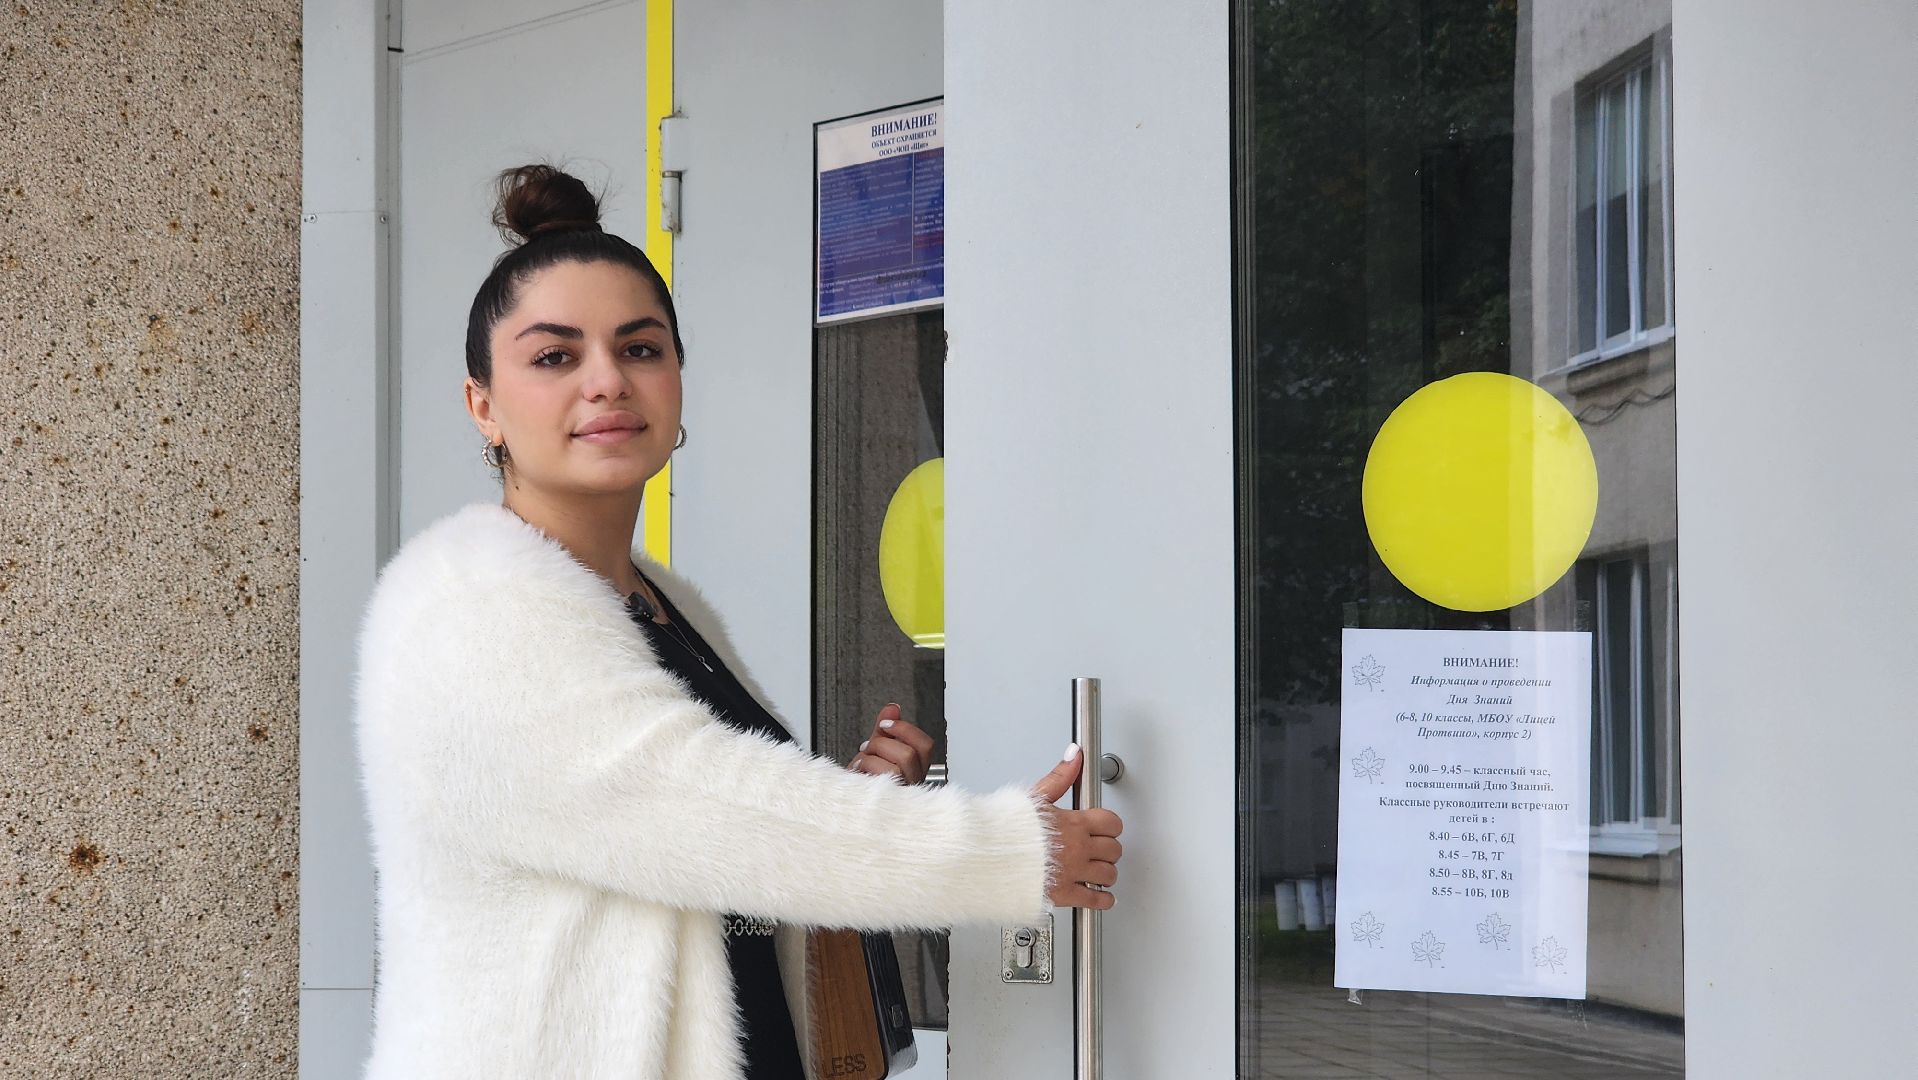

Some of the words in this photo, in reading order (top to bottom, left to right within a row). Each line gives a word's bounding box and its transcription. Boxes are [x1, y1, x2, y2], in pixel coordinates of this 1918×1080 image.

[871, 112, 937, 137] ВНИМАНИЕ!
[871, 137, 896, 149] ОБЪЕКТ
[896, 129, 937, 143] ОХРАНЯЕТСЯ
[879, 148, 892, 157] ООО
[1443, 657, 1519, 668] ВНИМАНИЕ!
[1410, 675, 1479, 687] Информация
[1491, 678, 1551, 688] проведении
[1446, 694, 1468, 705] Дня
[1473, 694, 1513, 705] Знаний
[1421, 712, 1433, 722] 10
[1435, 715, 1474, 724] классы,
[1477, 713, 1513, 723] МБОУ
[1516, 714, 1555, 725] «Лицей
[1417, 727, 1480, 740] Протвино»,
[1483, 731, 1519, 741] корпус
[1521, 729, 1532, 740] 2)
[1409, 764, 1430, 774] 9.00
[1440, 764, 1462, 775] 9.45
[1473, 766, 1526, 776] классный
[1530, 768, 1551, 777] час,
[1405, 779, 1480, 790] посвященный
[1482, 781, 1508, 792] Дню
[1510, 781, 1554, 792] Знаний.
[1379, 796, 1431, 808] Классные
[1433, 799, 1508, 810] руководители
[1511, 802, 1570, 812] встречают
[1449, 814, 1479, 824] детей
[1429, 831, 1450, 841] 8.40
[1461, 832, 1479, 843] 6В,
[1481, 832, 1498, 843] 6Г,
[1501, 833, 1515, 844] 6Д
[1438, 849, 1460, 860] 8.45
[1471, 850, 1488, 861] 7В,
[1491, 851, 1504, 861] 7Г
[1429, 867, 1450, 878] 8.50
[1461, 868, 1479, 880] 8В,
[1481, 869, 1498, 880] 8Г,
[1501, 870, 1513, 881] 8д
[1431, 886, 1453, 896] 8.55
[1465, 887, 1487, 899] 10Б,
[1491, 888, 1510, 898] 10В
